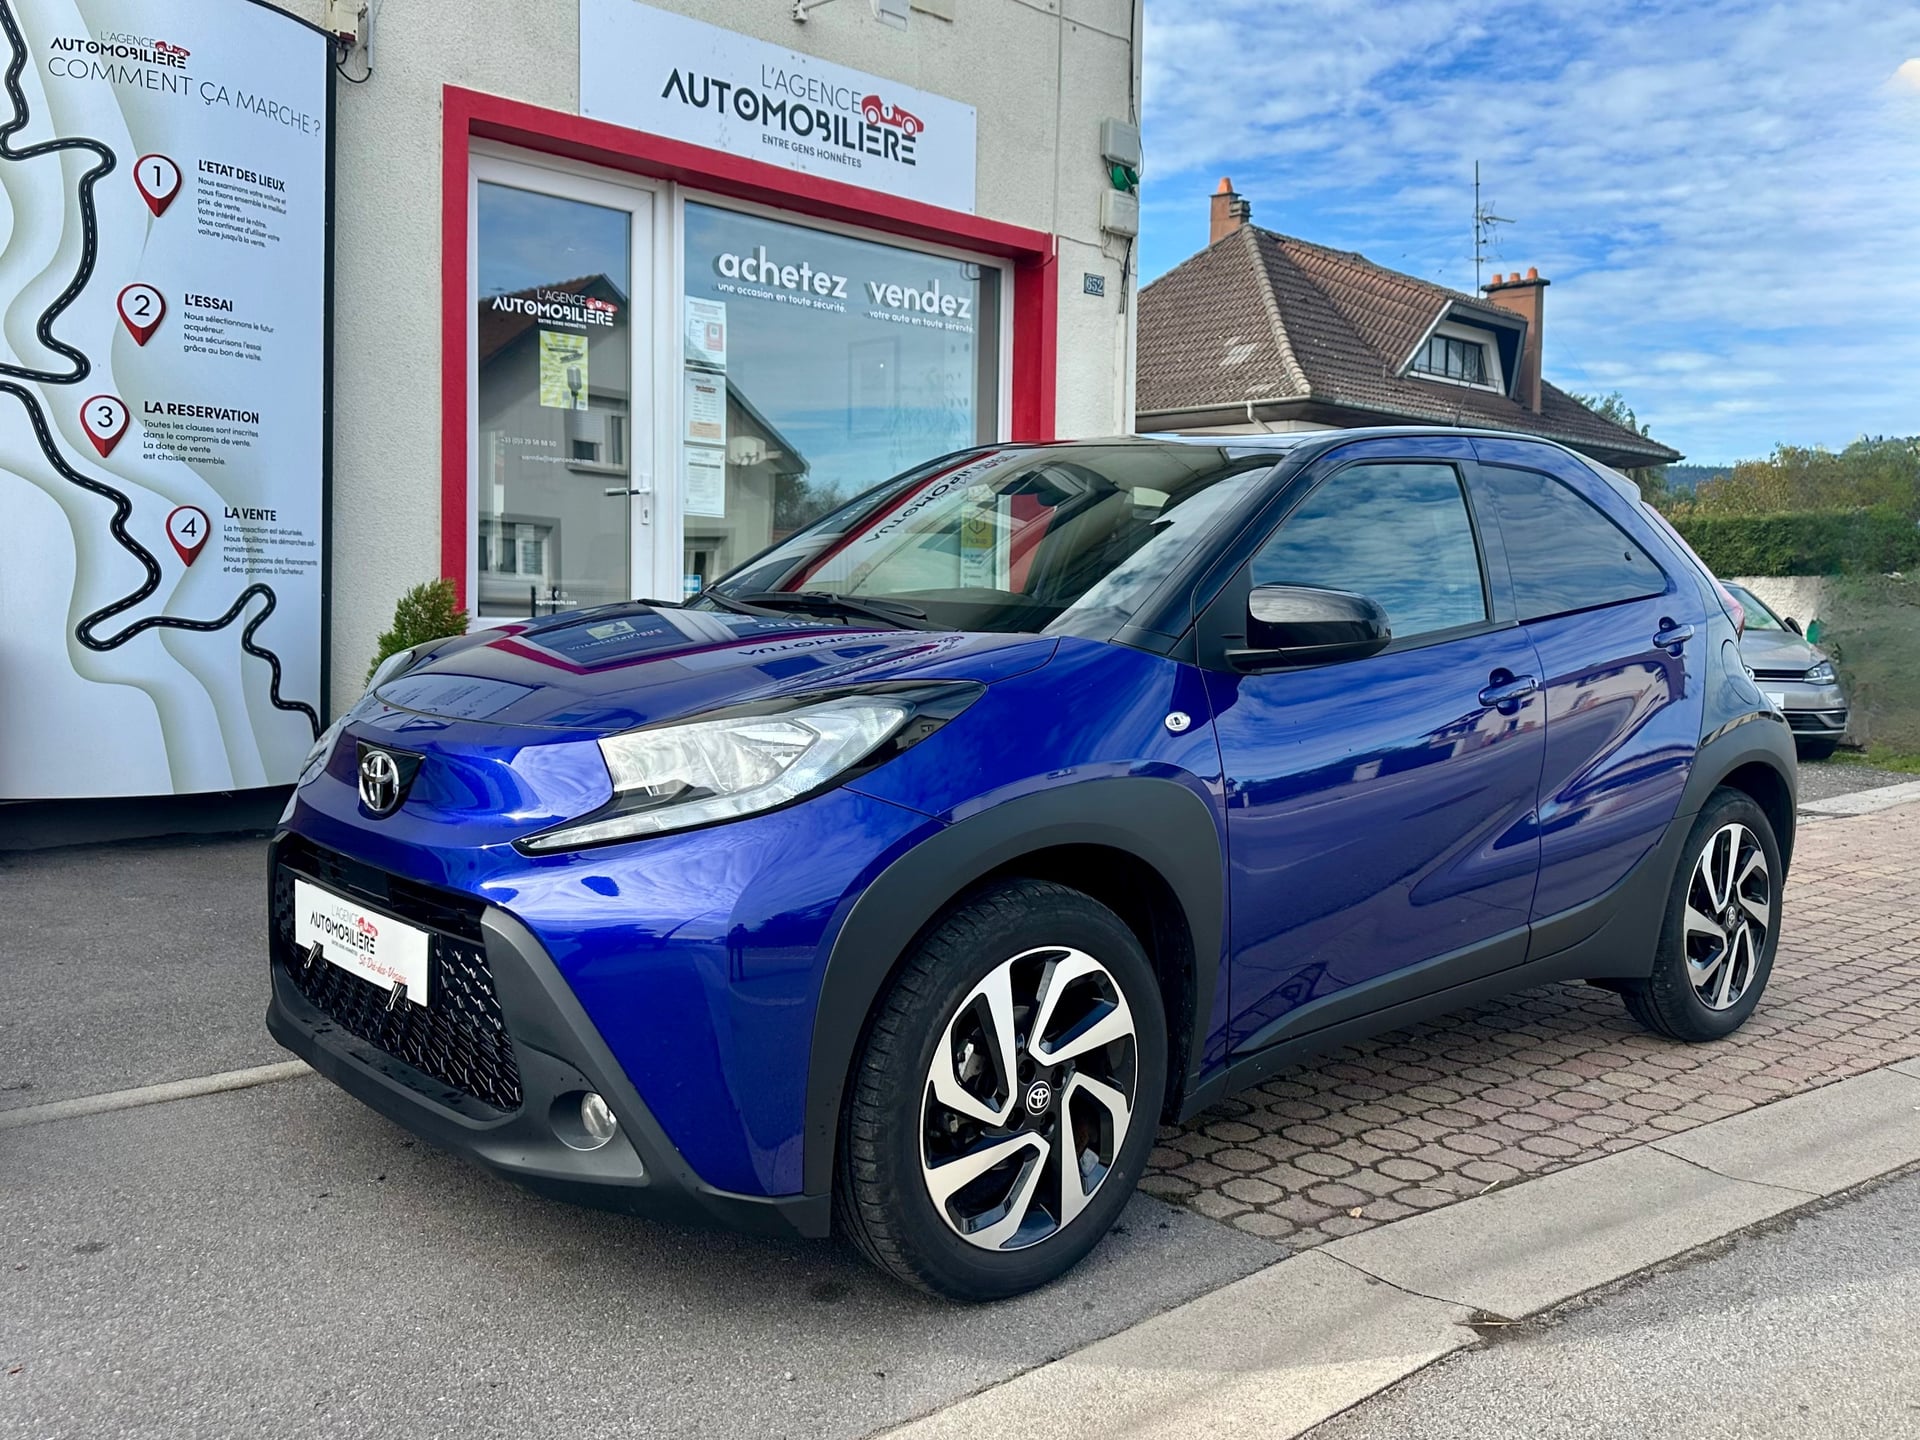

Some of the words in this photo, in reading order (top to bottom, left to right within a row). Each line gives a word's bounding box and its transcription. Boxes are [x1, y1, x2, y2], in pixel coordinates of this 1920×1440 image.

[100, 32, 156, 48] L'AGENCE
[48, 57, 193, 95] COMMENT
[200, 82, 230, 106] ÇA
[236, 90, 310, 134] MARCHE
[762, 64, 862, 115] L'AGENCE
[762, 134, 790, 150] ENTRE
[791, 140, 815, 156] GENS
[816, 146, 862, 168] HONNÊTES
[153, 166, 161, 186] 1
[199, 160, 234, 177] L'ETAT
[236, 168, 256, 184] DES
[259, 174, 285, 192] LIEUX
[198, 177, 214, 186] Nous
[216, 182, 248, 194] examinons
[198, 188, 214, 196] nous
[216, 190, 233, 200] fixons
[198, 198, 210, 206] prix
[214, 200, 222, 208] de
[198, 208, 214, 216] Votre
[216, 210, 236, 220] intérêt
[198, 217, 214, 226] Vous
[215, 221, 243, 232] continuez
[198, 228, 220, 237] voiture
[244, 236, 250, 244] la
[718, 246, 848, 298] achetez
[1086, 276, 1104, 292] 652
[134, 294, 150, 316] 2
[185, 294, 232, 312] L'ESSAI
[536, 289, 586, 306] L'AGENCE
[718, 282, 734, 293] une
[737, 286, 774, 300] occasion
[776, 293, 786, 302] en
[789, 293, 811, 306] toute
[813, 298, 847, 313] sécurité.
[870, 279, 972, 319] vendez
[184, 312, 204, 322] Nous
[205, 315, 252, 329] sélectionnons
[253, 322, 259, 330] le
[260, 324, 274, 333] futur
[869, 310, 889, 321] votre
[892, 313, 910, 324] auto
[912, 317, 922, 325] en
[923, 317, 943, 329] toute
[184, 332, 204, 342] Nous
[205, 336, 242, 348] sécurisons
[184, 344, 206, 352] grâce
[220, 347, 234, 356] bon
[235, 350, 244, 358] de
[97, 406, 113, 428] 3
[144, 400, 164, 414] LA
[167, 403, 259, 424] RESERVATION
[144, 420, 170, 429] Toutes
[172, 422, 184, 430] les
[186, 423, 214, 432] clauses
[216, 426, 231, 434] sont
[232, 428, 259, 438] inscrites
[143, 430, 164, 439] dans
[166, 432, 174, 440] le
[176, 434, 220, 444] compromis
[220, 437, 230, 446] de
[156, 442, 175, 450] date
[177, 443, 188, 452] de
[190, 446, 211, 454] vente
[143, 452, 156, 460] est
[158, 452, 186, 462] choisie
[224, 507, 240, 518] LA
[242, 508, 276, 521] VENTE
[180, 518, 197, 537] 4
[234, 526, 268, 534] transaction
[242, 557, 273, 565] proposons
[232, 566, 244, 574] des
[245, 567, 273, 576] garanties
